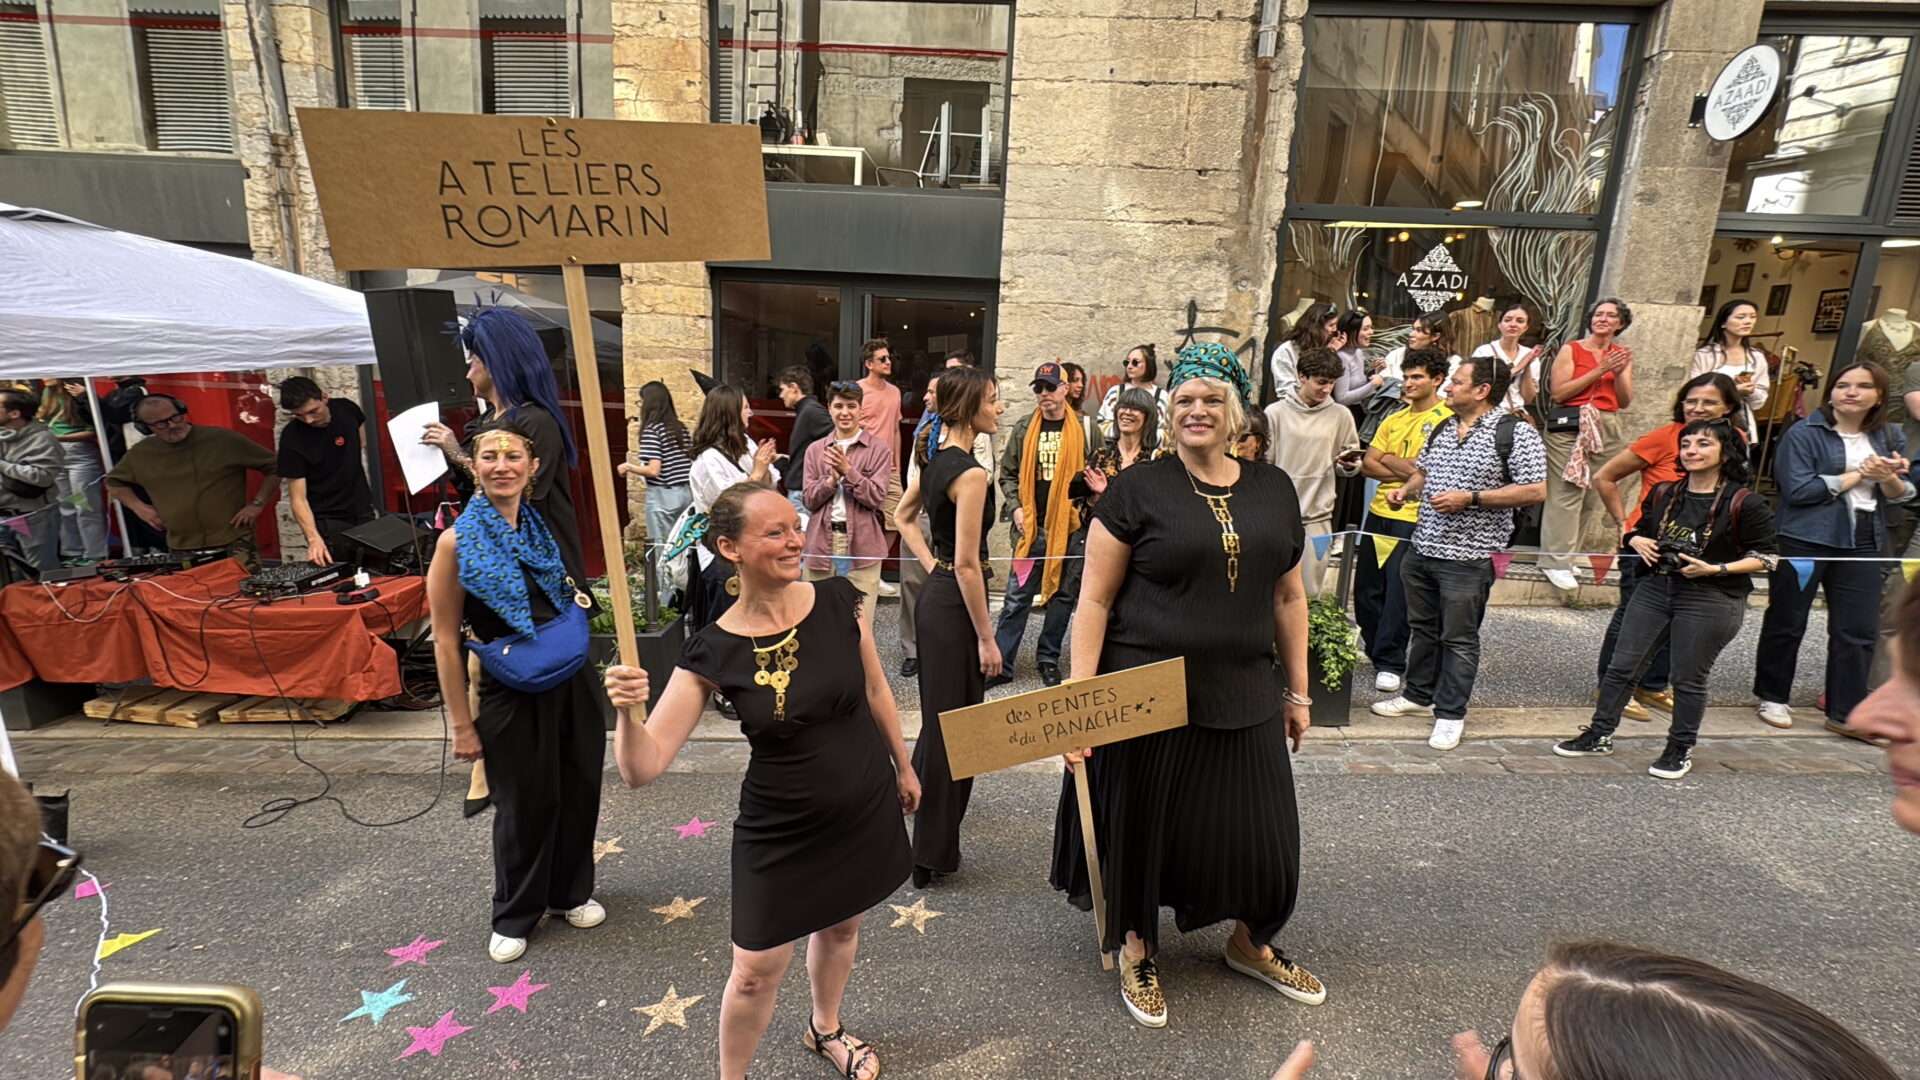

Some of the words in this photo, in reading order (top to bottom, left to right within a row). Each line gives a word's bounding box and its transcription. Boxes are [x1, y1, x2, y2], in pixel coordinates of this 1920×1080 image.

[1712, 76, 1772, 109] AZAADI
[518, 127, 582, 158] LES
[438, 160, 662, 197] ATELIERS
[440, 203, 670, 249] ROMARIN
[1396, 271, 1469, 290] AZAADI
[1005, 708, 1033, 725] des
[1037, 687, 1118, 719] PENTES
[1043, 703, 1132, 744] PANACHE
